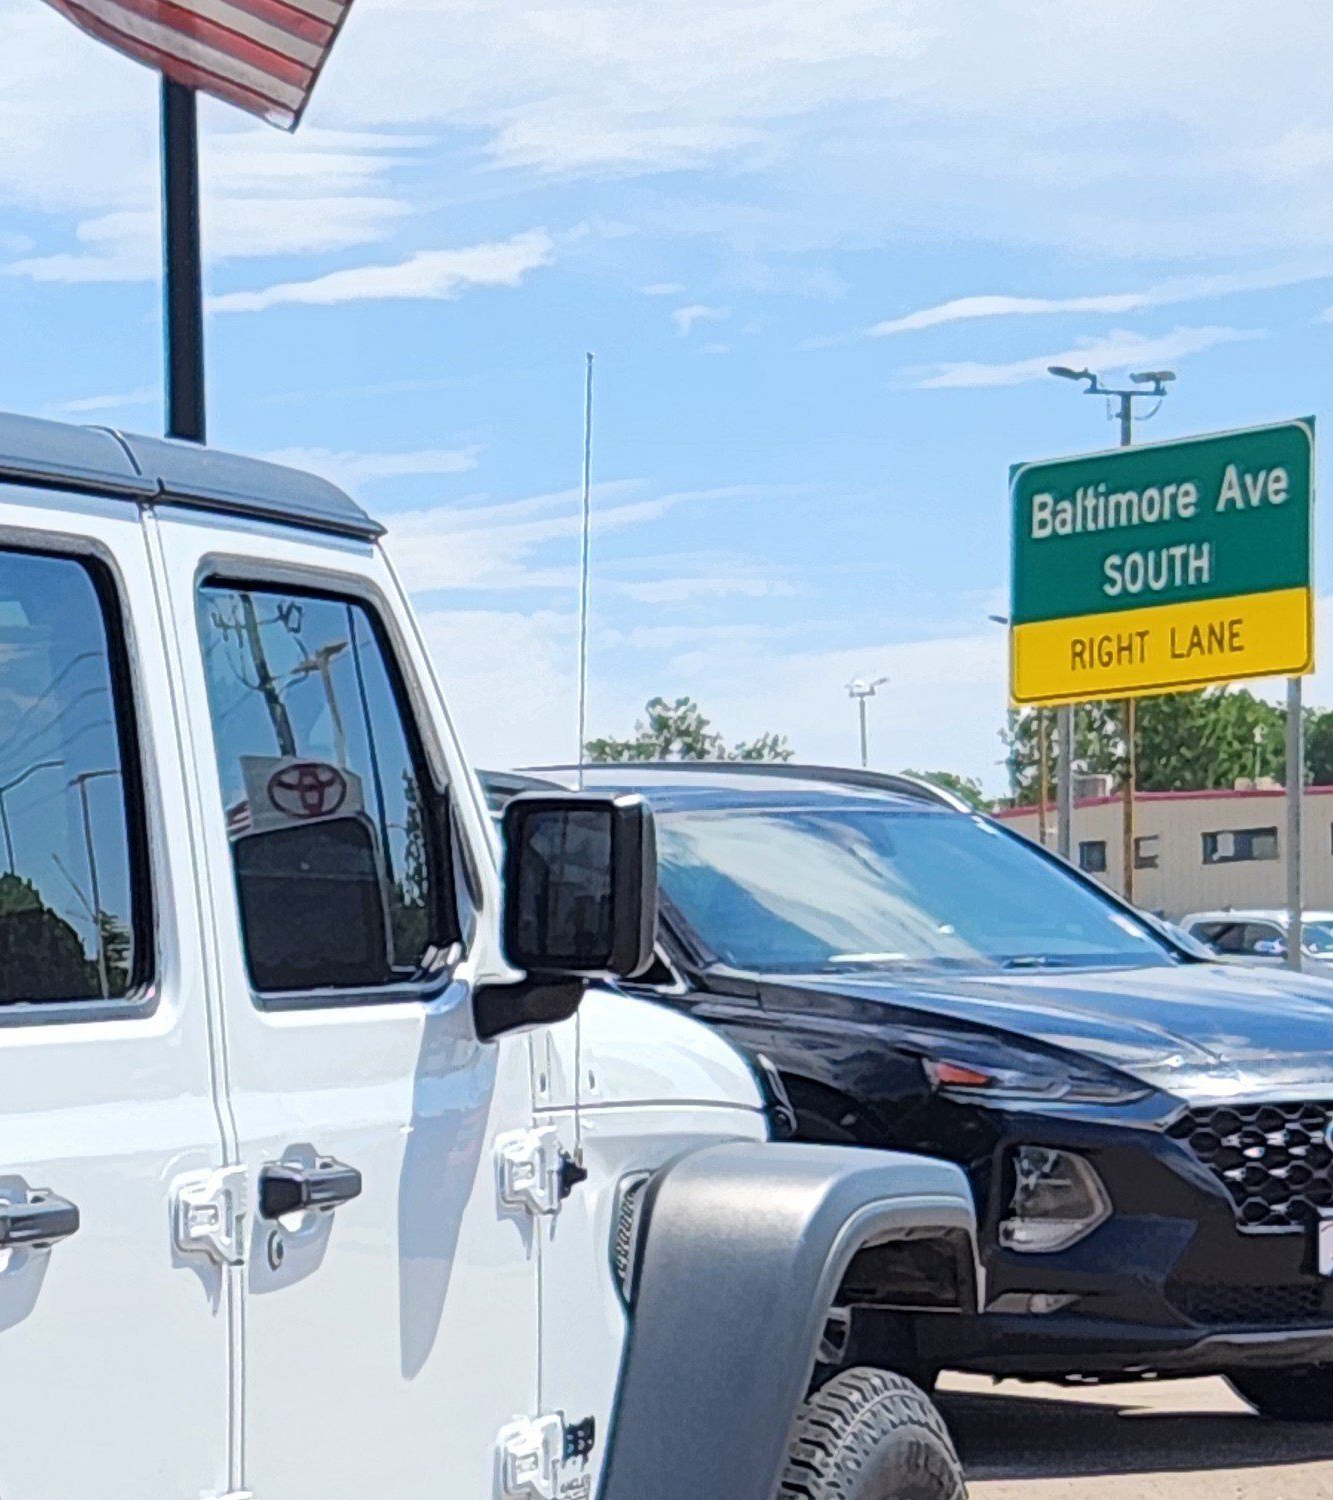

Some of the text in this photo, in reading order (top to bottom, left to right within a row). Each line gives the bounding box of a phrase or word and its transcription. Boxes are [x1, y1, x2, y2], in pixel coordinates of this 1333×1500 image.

[1031, 464, 1289, 538] Baltimore Ave
[1103, 542, 1211, 596] SOUTH
[1071, 619, 1245, 671] RIGHT LANE
